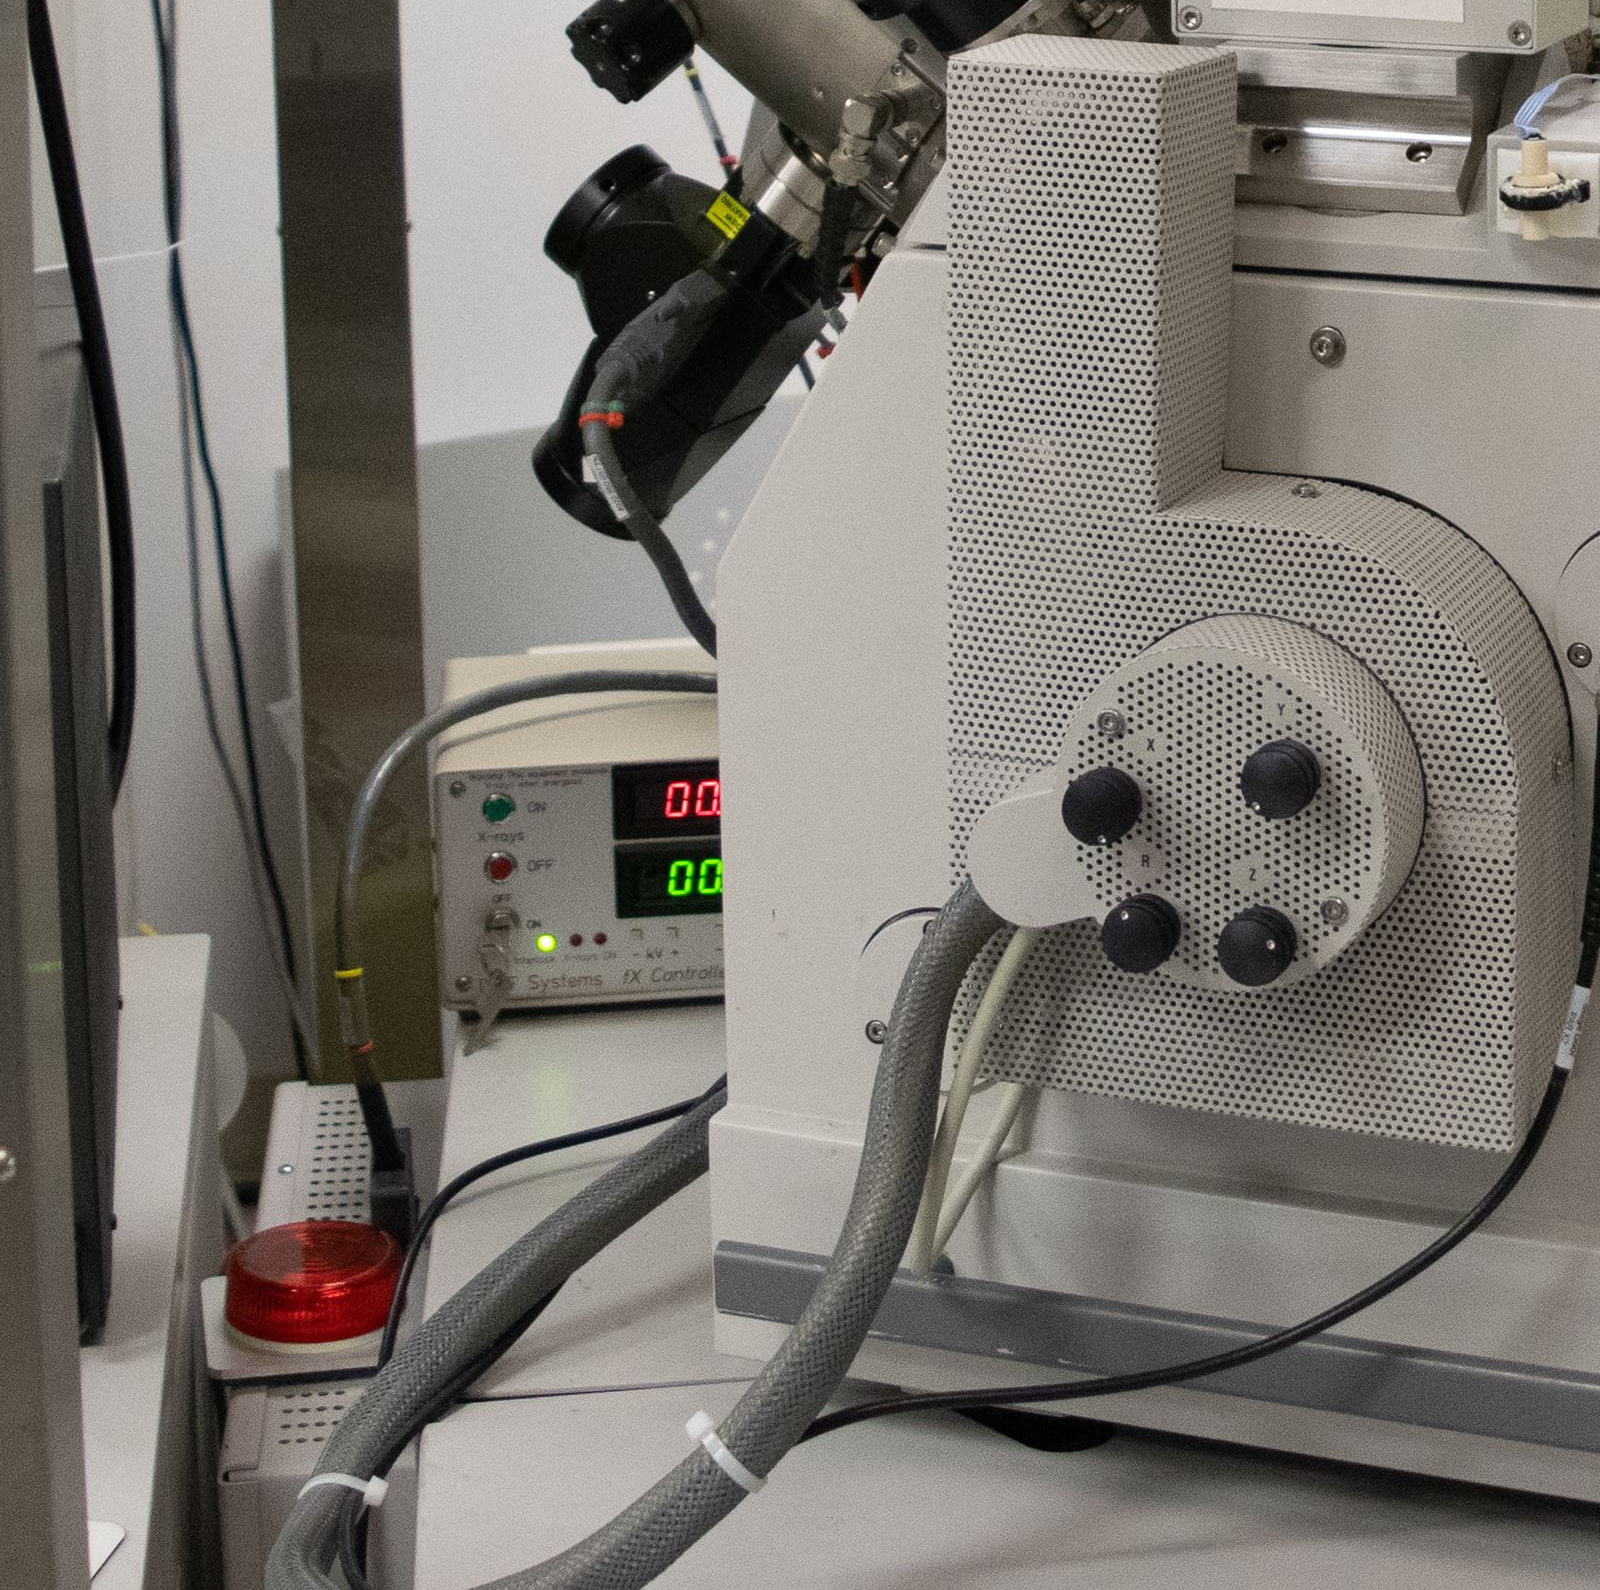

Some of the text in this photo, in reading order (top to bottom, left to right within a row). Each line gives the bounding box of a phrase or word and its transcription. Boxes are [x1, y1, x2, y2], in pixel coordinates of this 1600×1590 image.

[1277, 702, 1285, 716] Y
[1146, 738, 1155, 752] X
[477, 831, 525, 843] X-rays
[527, 859, 553, 872] OFF
[1141, 854, 1150, 868] R
[1249, 868, 1257, 882] Z
[528, 974, 604, 993] Systems
